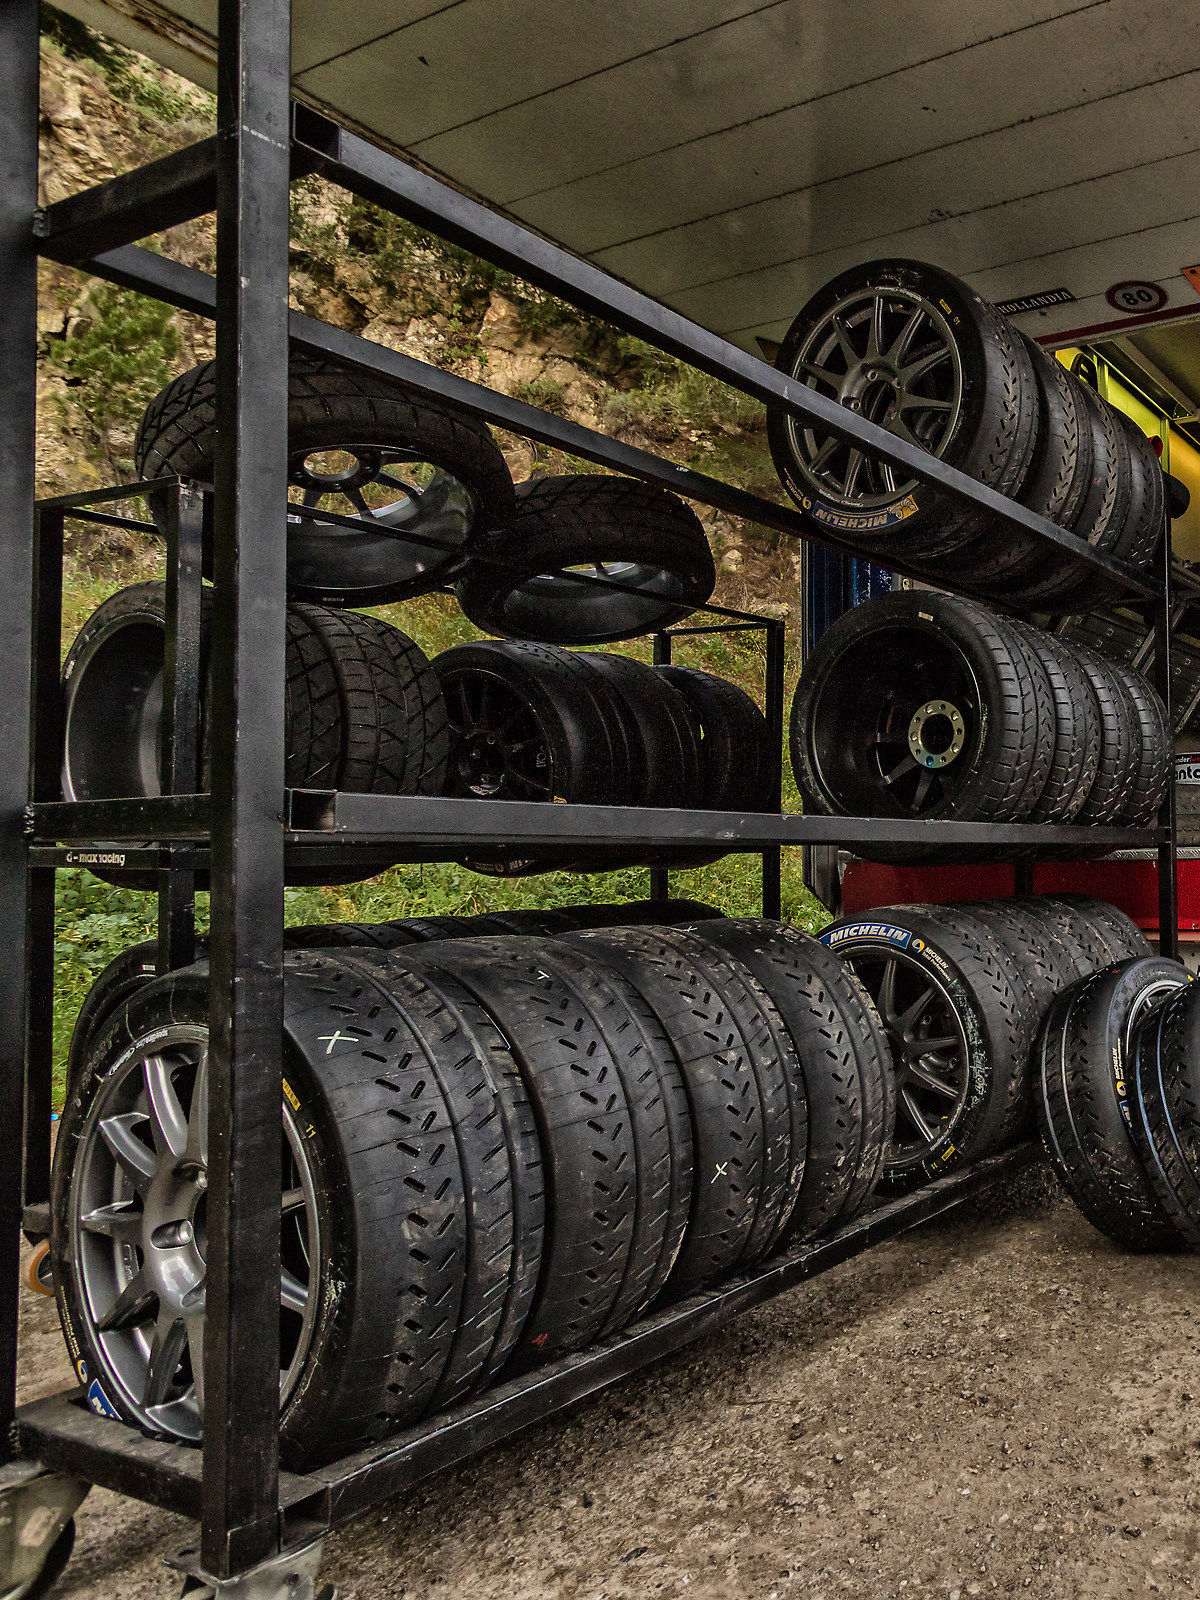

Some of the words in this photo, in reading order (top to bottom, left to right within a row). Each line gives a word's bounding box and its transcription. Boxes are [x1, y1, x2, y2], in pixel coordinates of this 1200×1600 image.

[999, 291, 1070, 313] HOLLANDIA
[1121, 290, 1153, 306] 80
[815, 508, 887, 529] MICHELIN
[830, 926, 908, 943] MICHELIN
